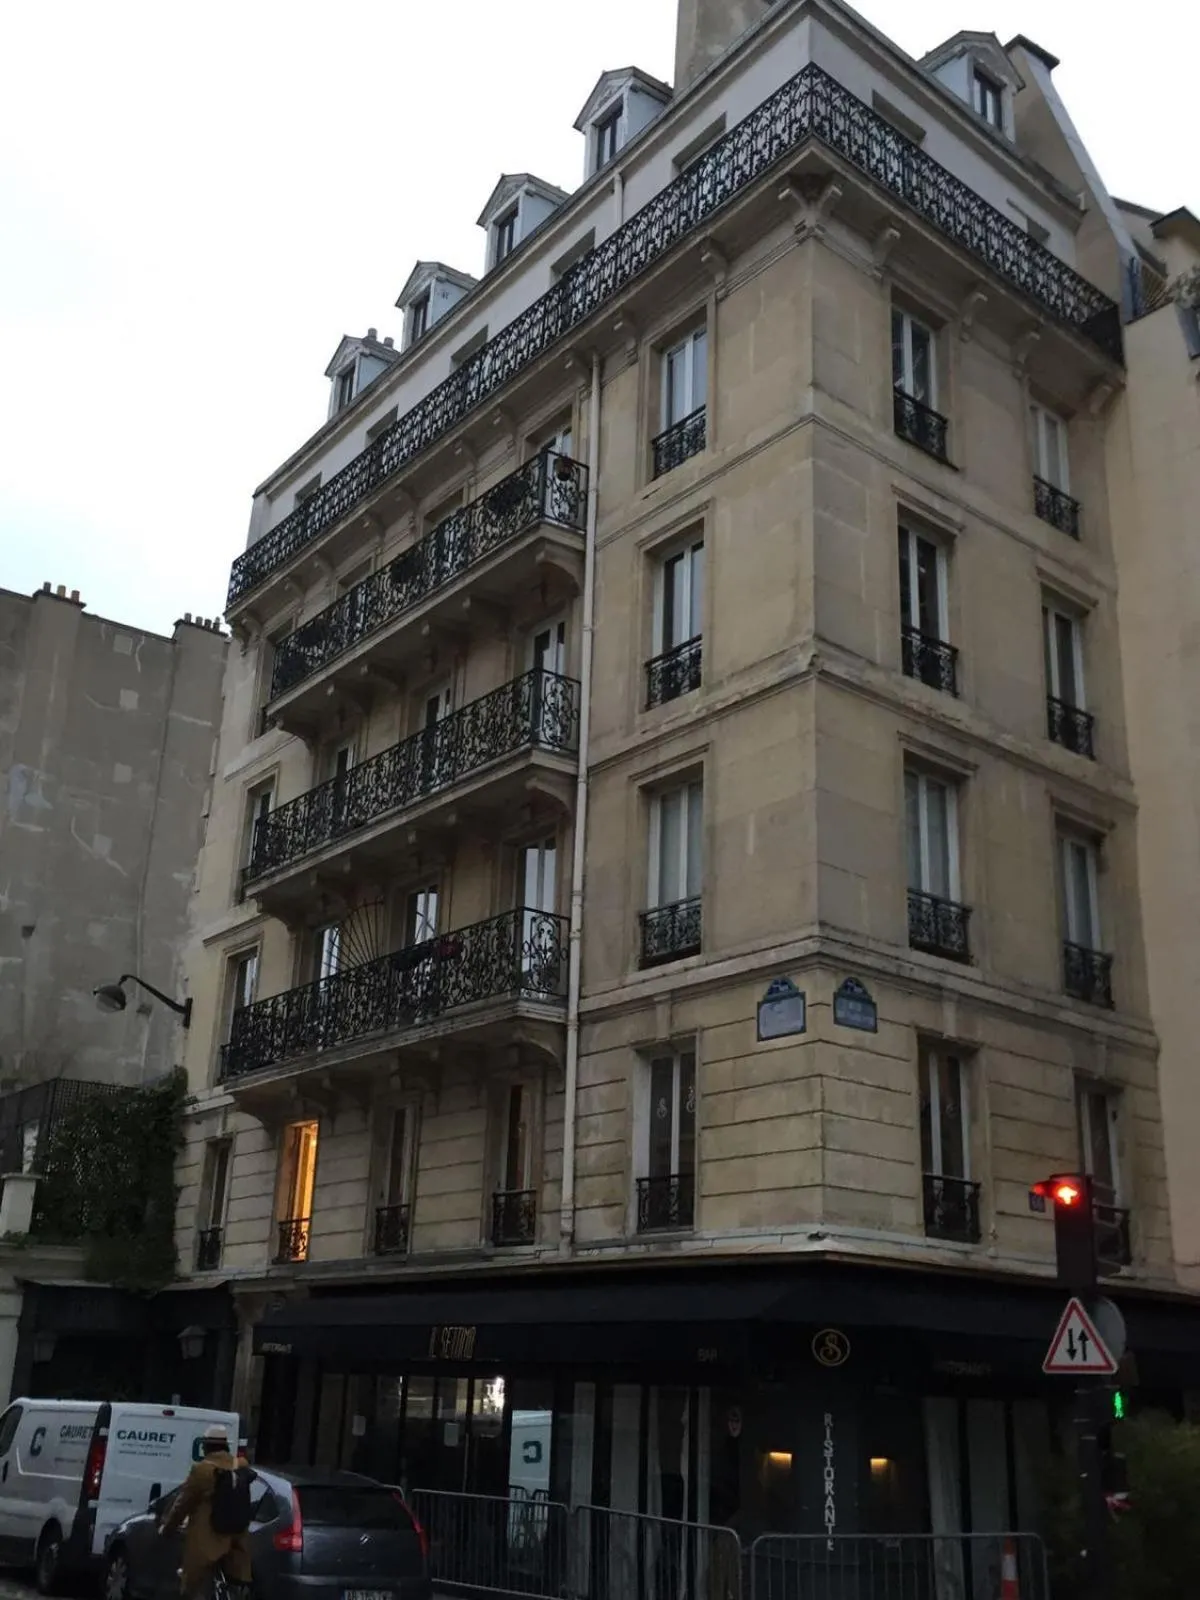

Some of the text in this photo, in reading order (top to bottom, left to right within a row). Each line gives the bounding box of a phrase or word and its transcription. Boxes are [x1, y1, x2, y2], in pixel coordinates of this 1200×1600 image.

[30, 1427, 46, 1456] C
[116, 1429, 177, 1444] CAURET
[823, 1412, 837, 1551] RISTORANTE
